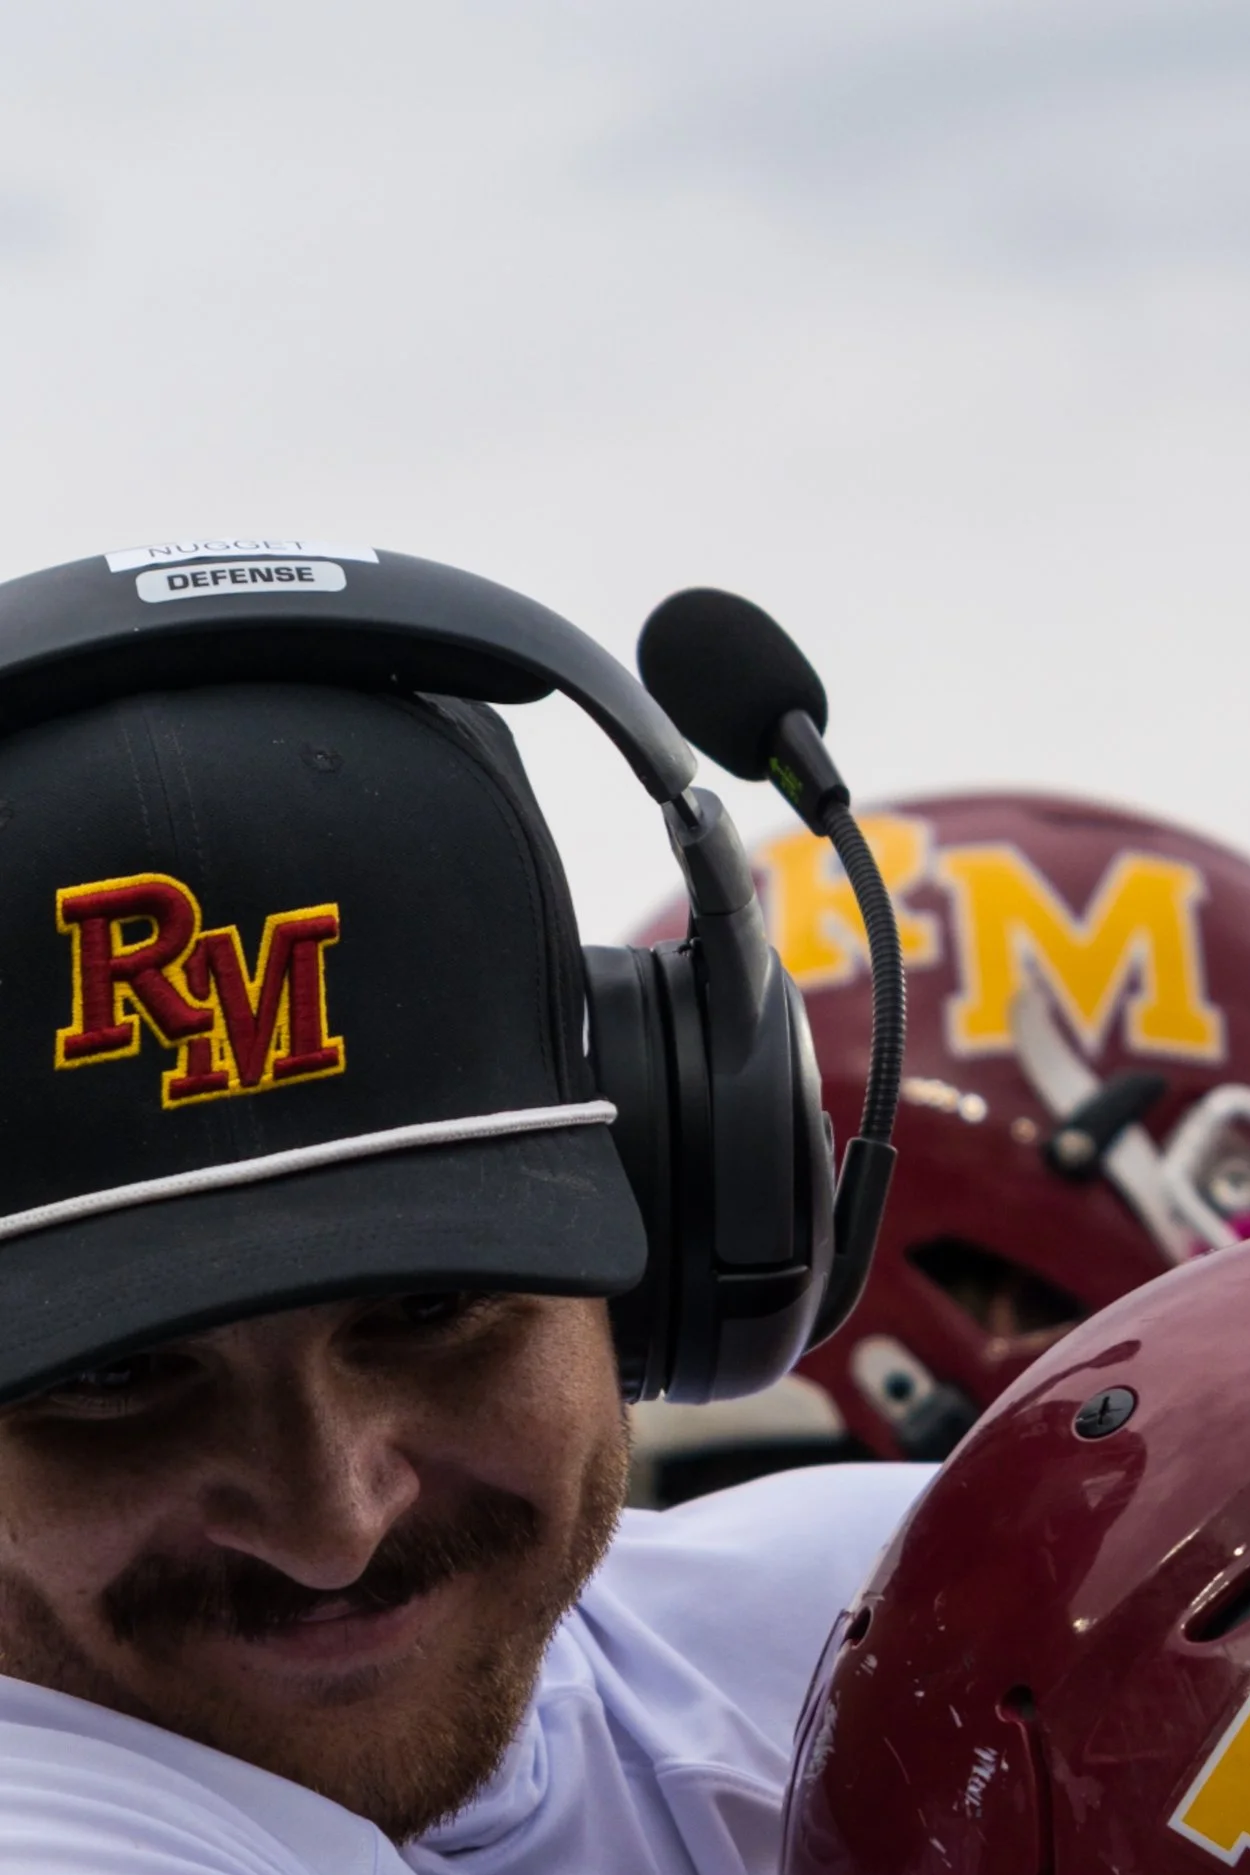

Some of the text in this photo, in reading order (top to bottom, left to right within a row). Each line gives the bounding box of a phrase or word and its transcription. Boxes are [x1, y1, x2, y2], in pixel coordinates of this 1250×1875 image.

[148, 539, 307, 559] NUGGET
[166, 566, 315, 591] DEFENSE
[54, 871, 347, 1111] RM
[758, 812, 1224, 1063] RM
